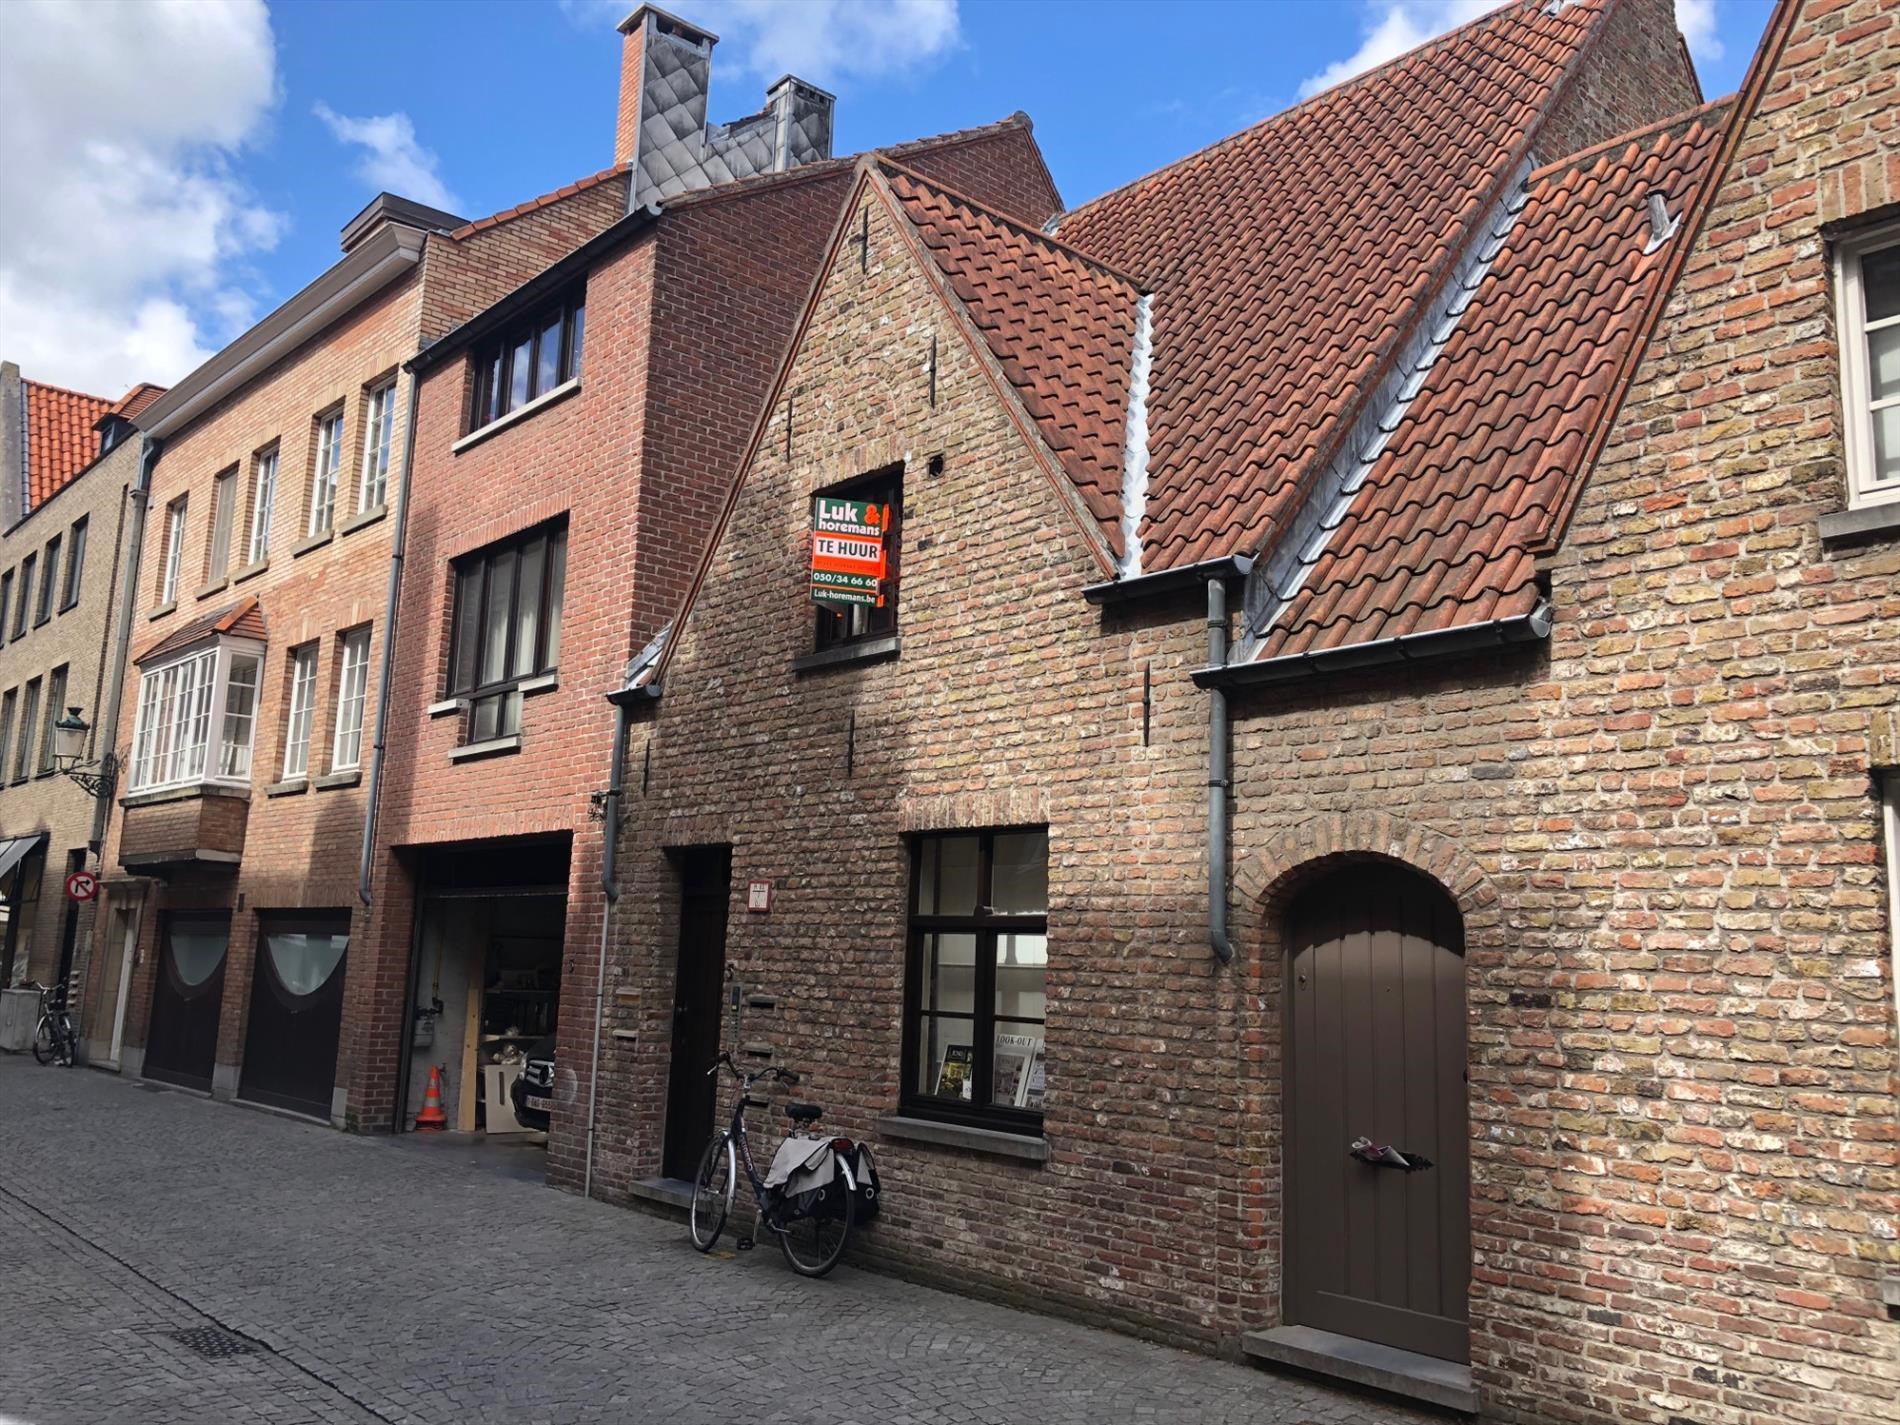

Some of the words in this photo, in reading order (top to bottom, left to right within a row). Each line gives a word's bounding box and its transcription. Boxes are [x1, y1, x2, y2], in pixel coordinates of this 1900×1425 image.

[819, 500, 858, 522] Luk
[864, 504, 881, 524] &
[818, 519, 880, 536] horemans
[818, 539, 834, 553] TE
[838, 544, 878, 559] HUUR
[813, 572, 849, 584] 050/34
[851, 577, 863, 586] 66
[865, 578, 878, 588] 60
[814, 589, 876, 604] Luk-horemans.be
